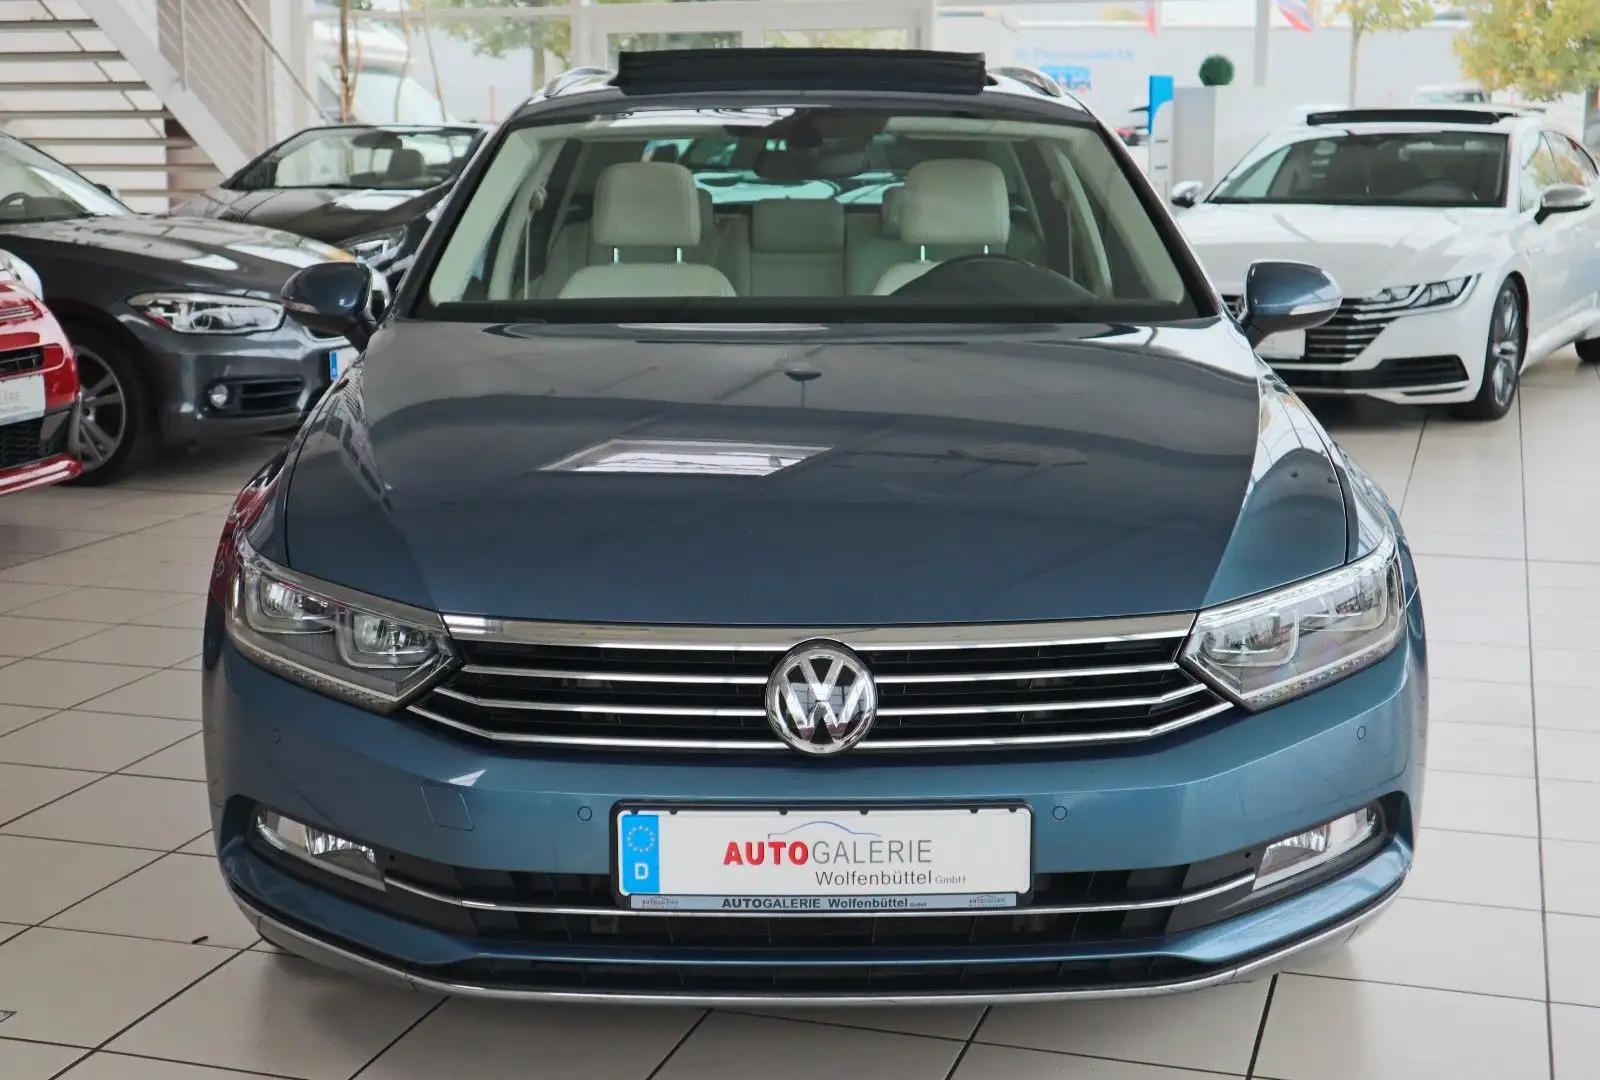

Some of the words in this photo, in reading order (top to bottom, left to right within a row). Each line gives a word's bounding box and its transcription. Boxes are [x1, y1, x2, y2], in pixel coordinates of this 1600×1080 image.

[723, 839, 932, 866] AUTOGALERIE
[634, 863, 649, 880] D
[815, 870, 931, 886] Wolfenbüttel
[935, 875, 966, 885] GmbH
[722, 898, 820, 908] AUTOGALERIE
[828, 897, 908, 909] Wolfenbüttel
